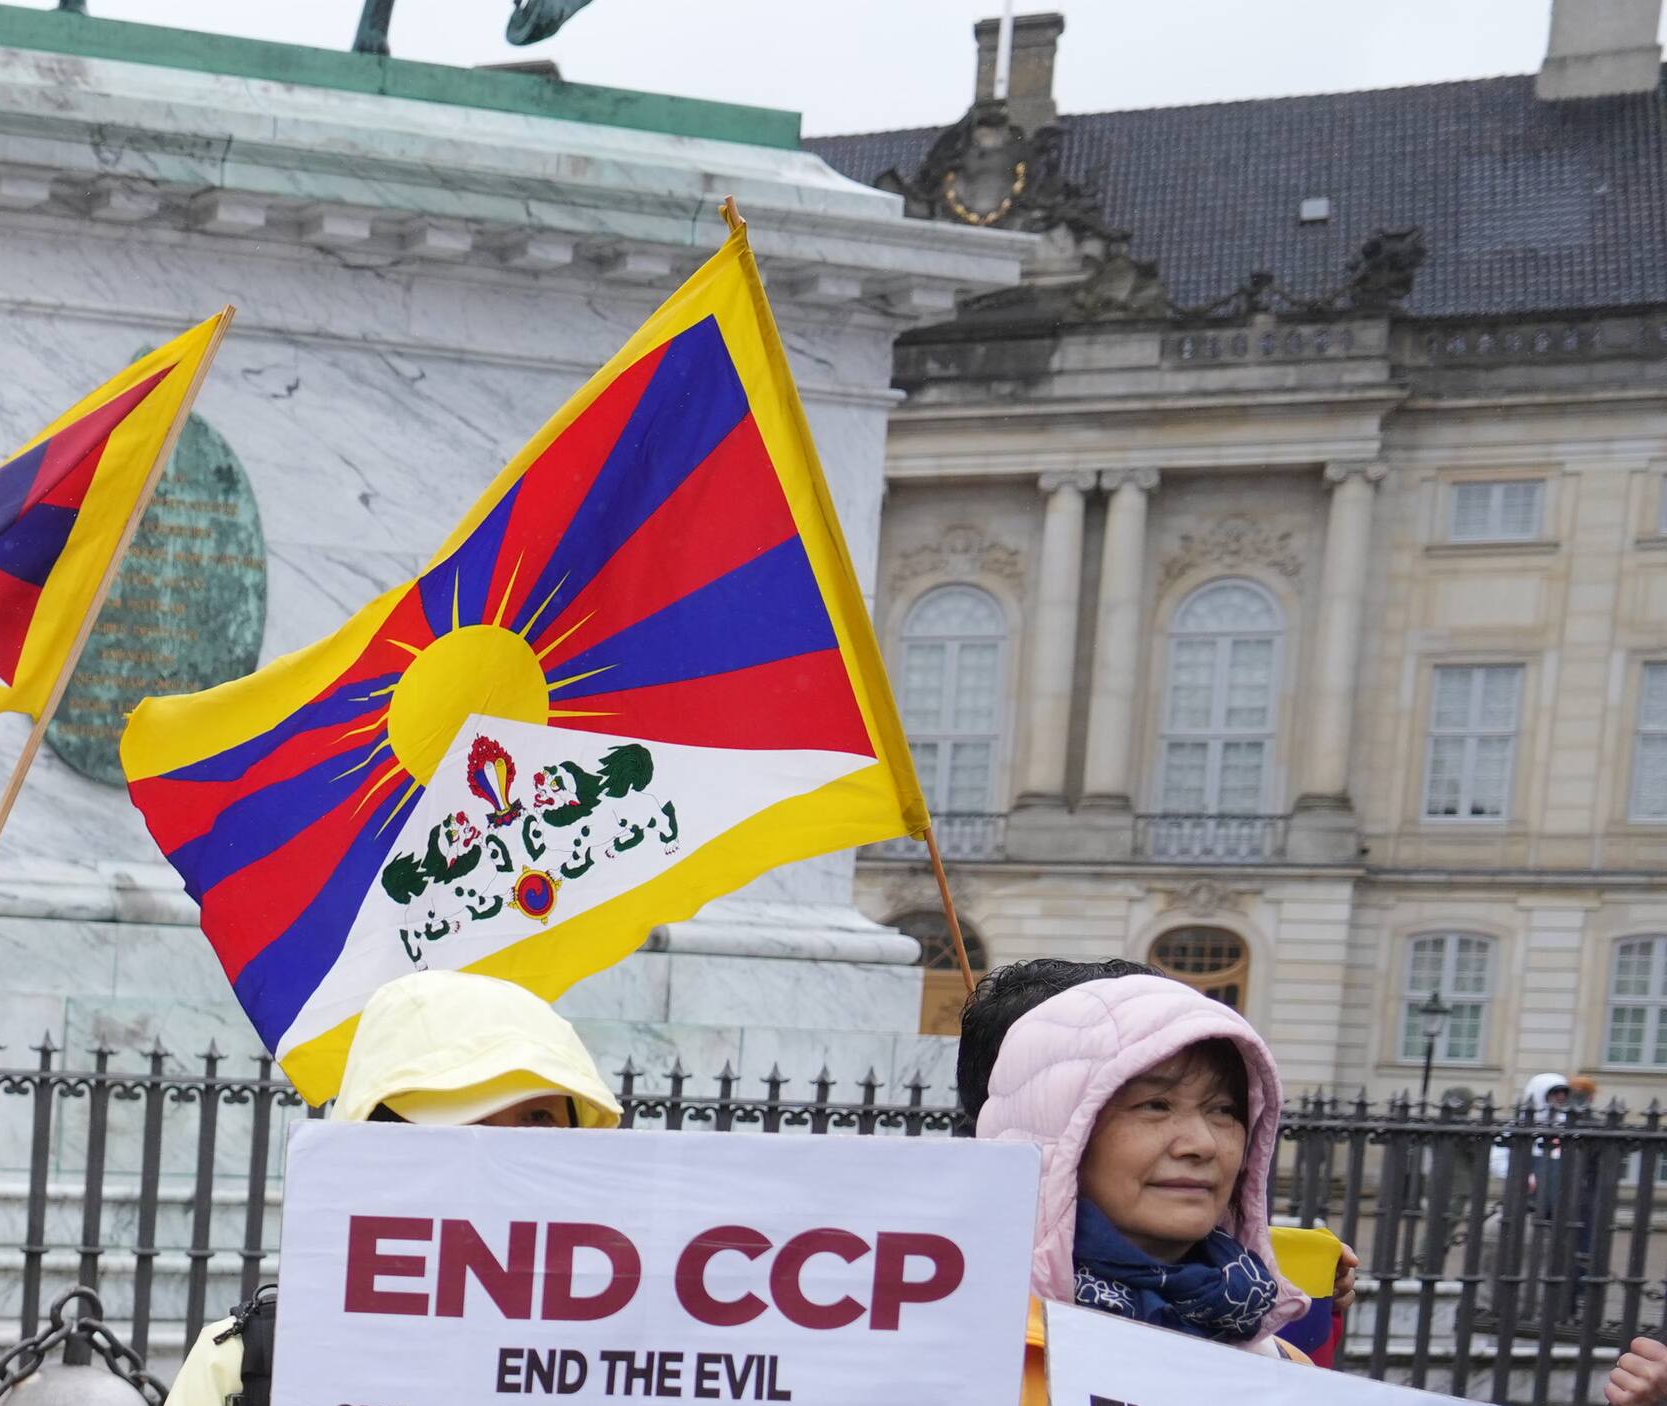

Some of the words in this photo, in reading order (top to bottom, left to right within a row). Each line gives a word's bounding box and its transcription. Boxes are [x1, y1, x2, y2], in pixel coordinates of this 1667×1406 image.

[344, 1215, 642, 1321] END
[676, 1225, 965, 1330] CCP
[496, 1347, 588, 1395] END
[600, 1350, 684, 1398] THE
[694, 1353, 793, 1402] EVIL
